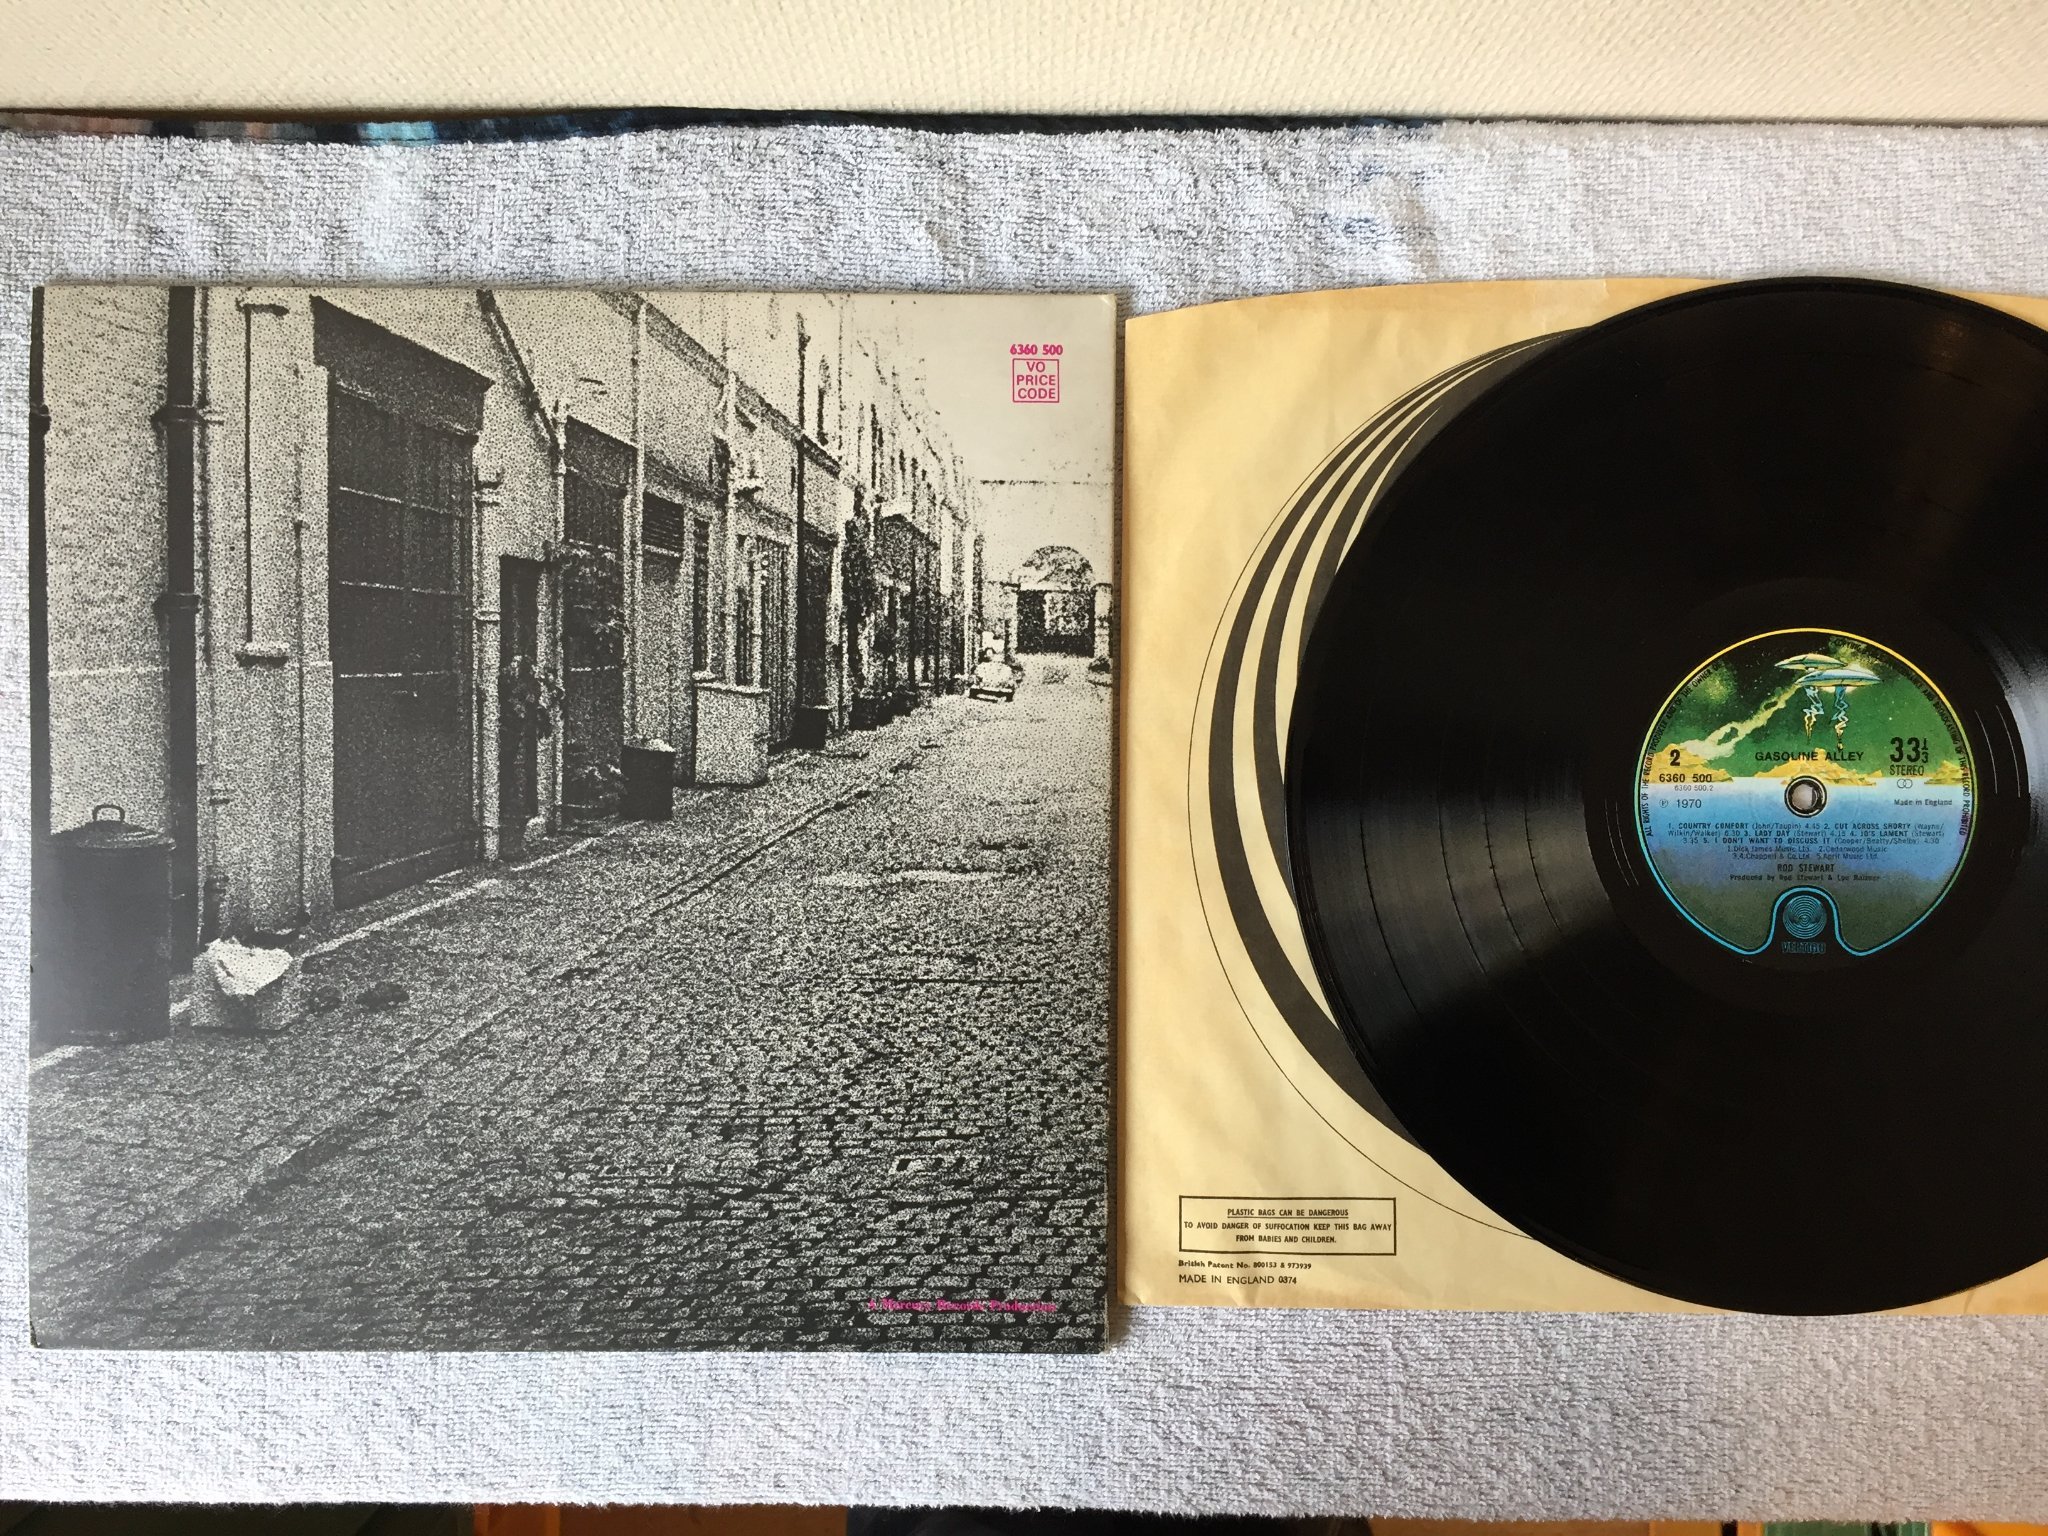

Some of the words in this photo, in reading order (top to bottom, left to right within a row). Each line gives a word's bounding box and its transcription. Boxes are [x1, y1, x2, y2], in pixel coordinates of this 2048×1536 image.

[1010, 344, 1038, 355] 6360
[1042, 344, 1063, 355] 500
[1026, 362, 1045, 372] VO
[1016, 375, 1056, 386] PRICE
[1018, 388, 1055, 398] CODE
[1670, 749, 1680, 766] 2
[1755, 752, 1818, 760] GASOLINE
[1825, 752, 1864, 760] ALLEY
[1890, 765, 1924, 776] STEREO
[1659, 774, 1685, 782] 6360
[1693, 774, 1712, 782] 500
[1677, 799, 1702, 808] 1970
[1179, 1275, 1206, 1284] MADE
[1212, 1275, 1221, 1284] IN
[1226, 1275, 1274, 1284] ENGLAND
